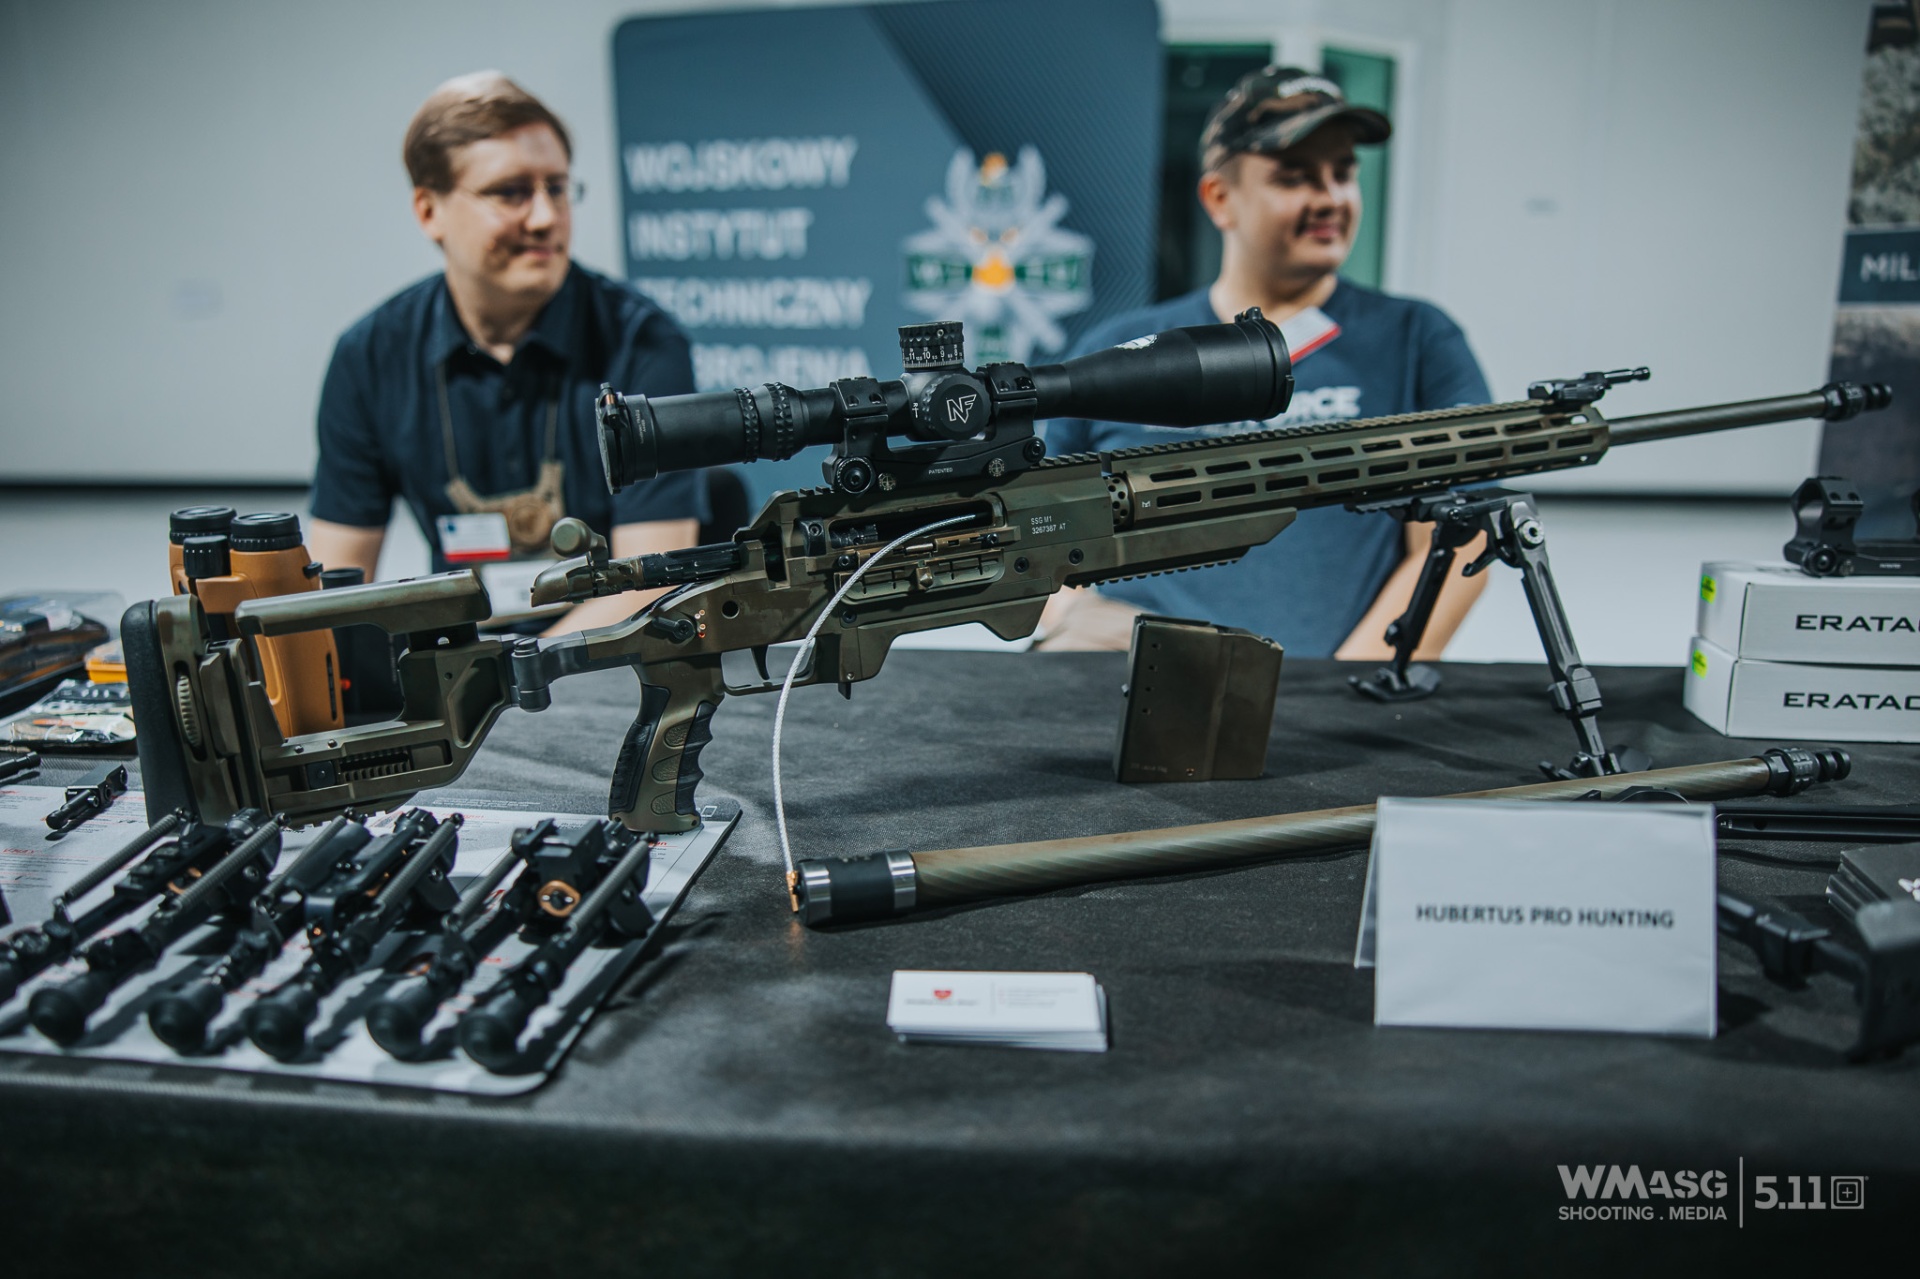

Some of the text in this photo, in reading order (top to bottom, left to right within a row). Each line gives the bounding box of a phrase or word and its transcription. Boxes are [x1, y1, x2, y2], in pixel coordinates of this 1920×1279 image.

[624, 136, 858, 192] WOJSKOWY
[629, 208, 814, 260] INSTYTUT
[922, 351, 931, 360] 10
[946, 394, 977, 424] NF
[928, 467, 953, 475] PATENTED
[1031, 517, 1043, 525] SSG
[1795, 614, 1920, 633] ERATA
[1416, 904, 1675, 929] HUBERTUS PRO HUNTING
